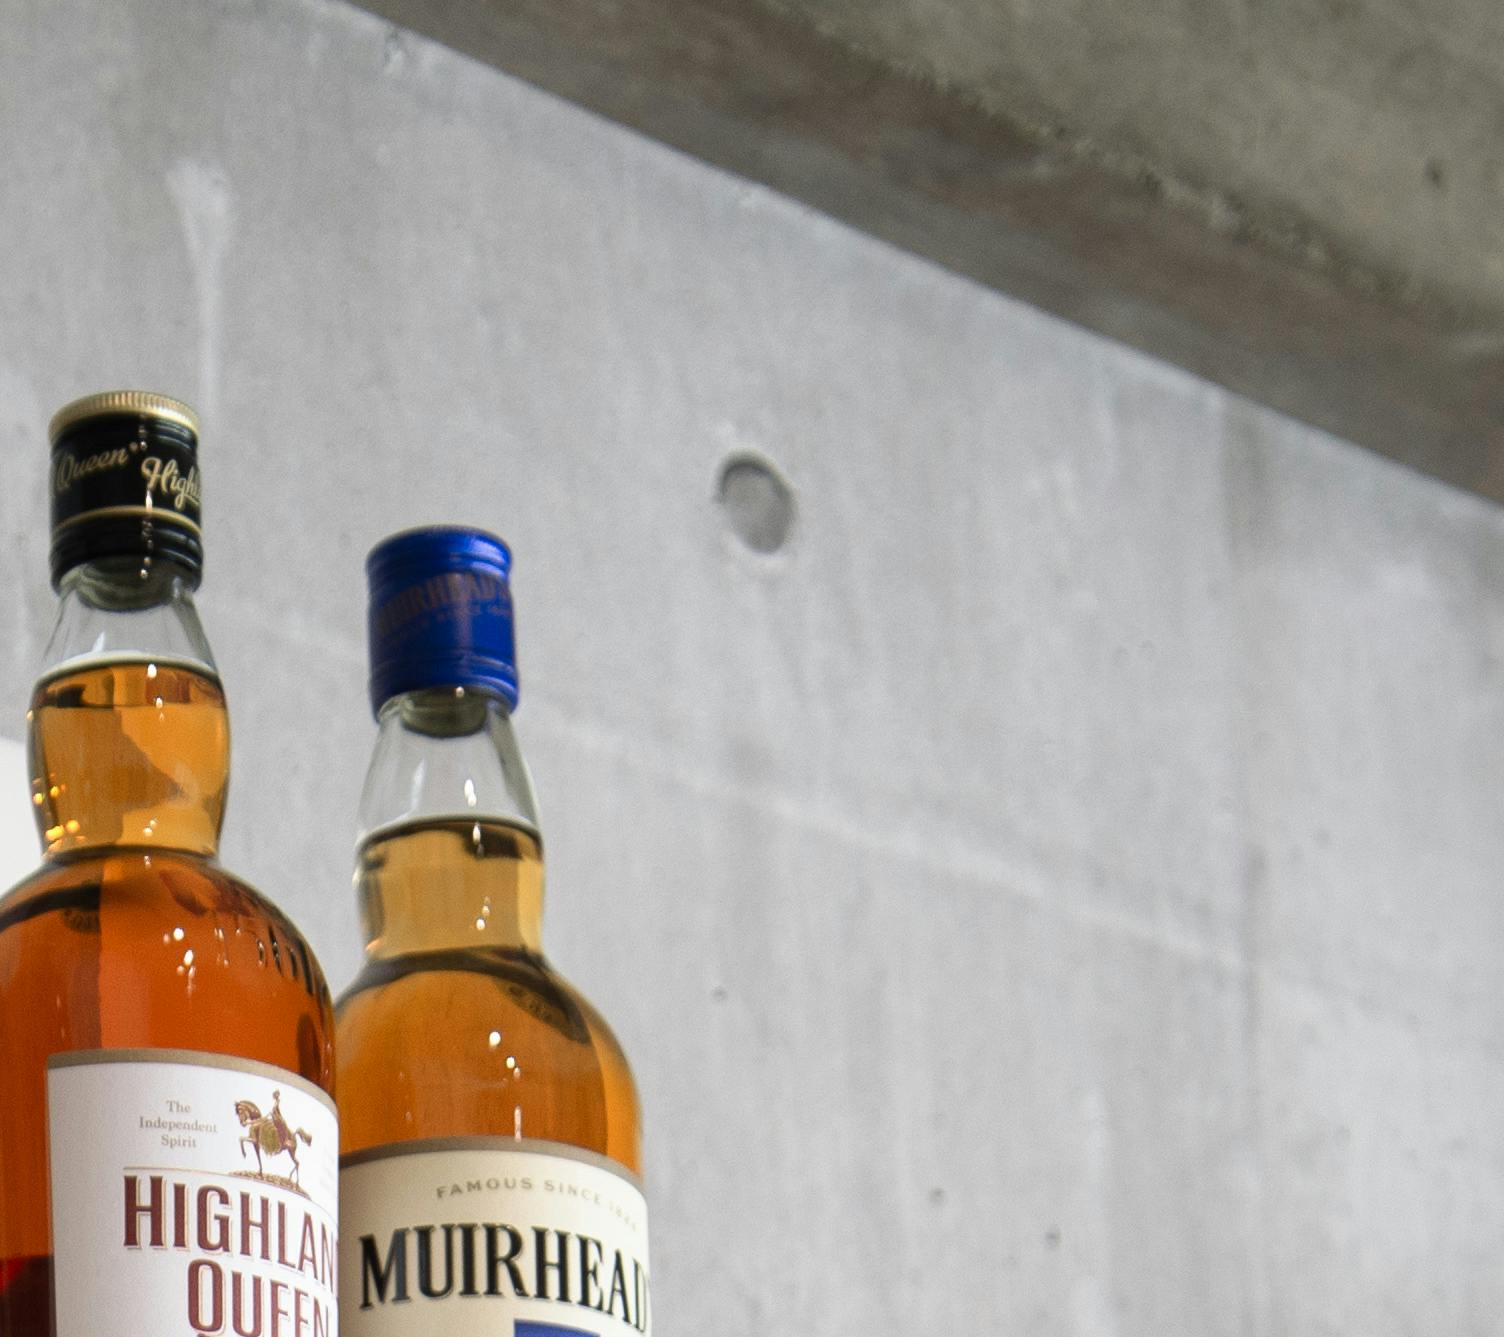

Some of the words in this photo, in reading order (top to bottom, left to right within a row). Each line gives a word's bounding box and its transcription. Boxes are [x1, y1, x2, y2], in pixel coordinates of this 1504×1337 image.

[55, 447, 129, 490] Queen
[165, 1099, 191, 1114] The
[139, 1115, 218, 1134] Independent
[160, 1134, 197, 1150] Spirit
[435, 1176, 533, 1200] FAMOUS
[543, 1178, 602, 1207] SINCE
[123, 1174, 338, 1297] HIGHLAN
[357, 1221, 650, 1335] MUIRHEAD
